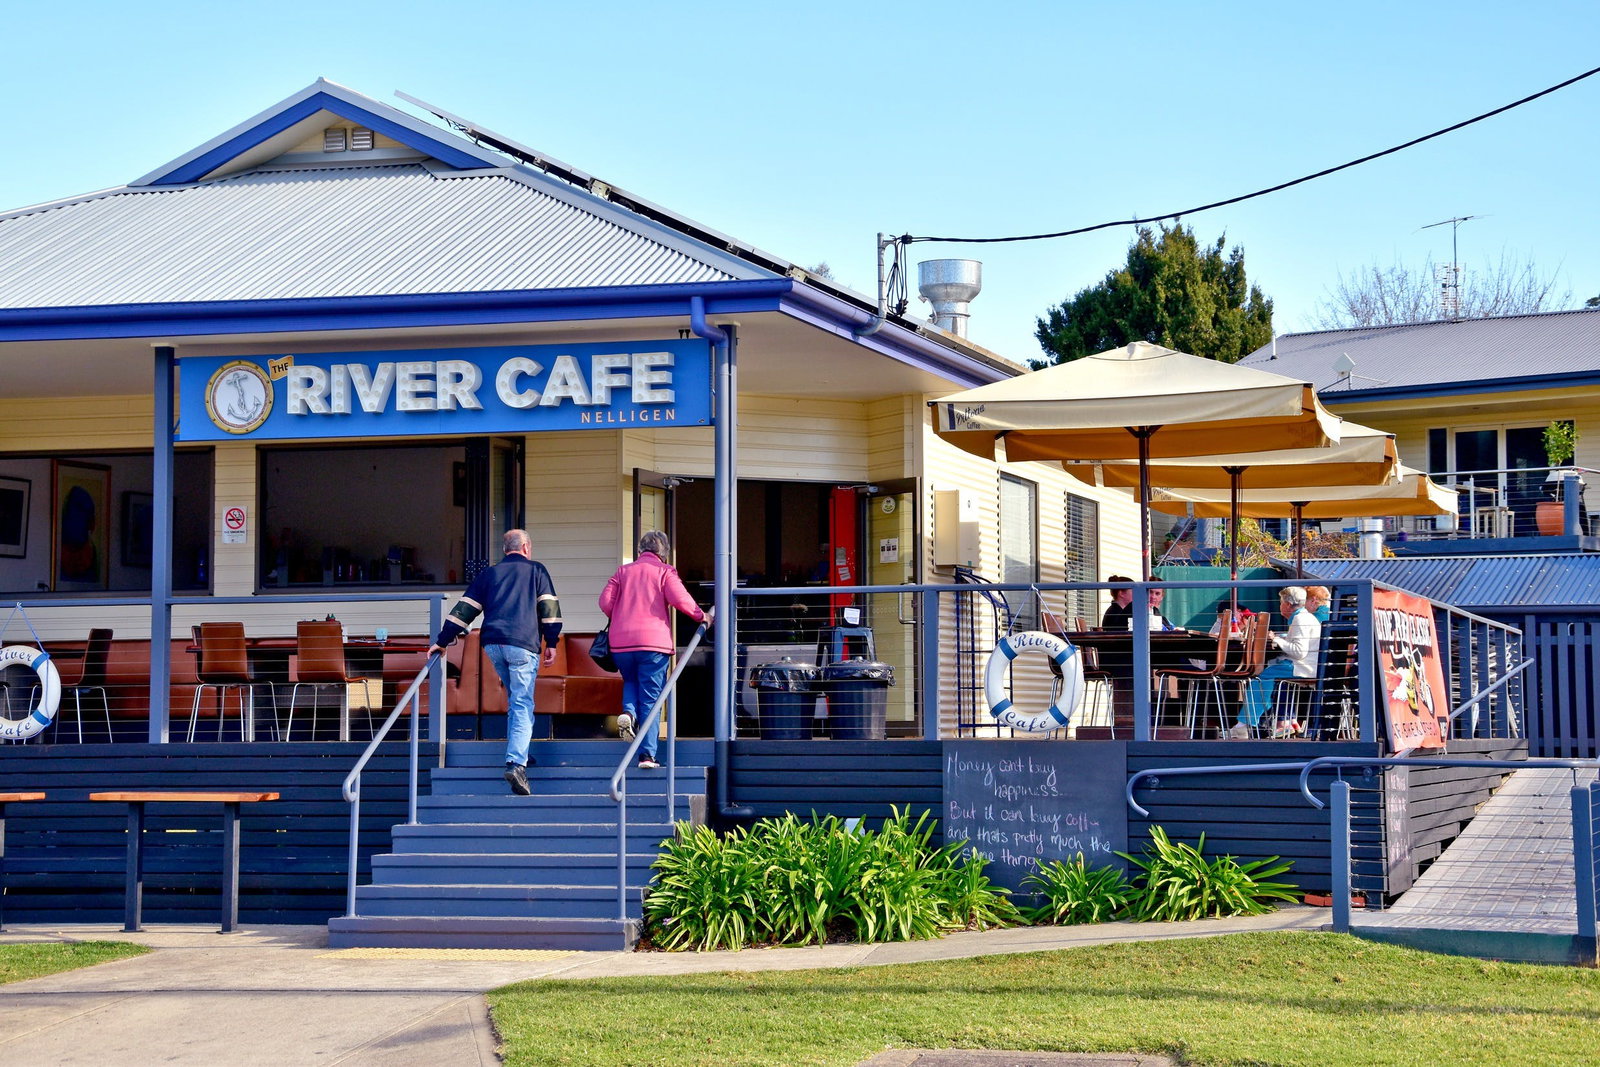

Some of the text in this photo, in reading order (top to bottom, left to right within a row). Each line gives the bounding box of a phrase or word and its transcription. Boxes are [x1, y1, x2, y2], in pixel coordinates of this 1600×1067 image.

[271, 362, 289, 374] THE
[287, 352, 675, 414] RIVER CAFE
[580, 408, 677, 424] NELLIGEN
[1014, 633, 1061, 652] River
[1005, 711, 1049, 732] Café
[947, 751, 994, 786] Money
[1029, 756, 1056, 787] buy
[950, 799, 976, 820] But
[1000, 808, 1025, 822] can
[1030, 804, 1061, 832] buy
[947, 826, 969, 841] and
[1015, 829, 1044, 855] pretty
[1050, 834, 1083, 852] much
[1090, 836, 1113, 853] the
